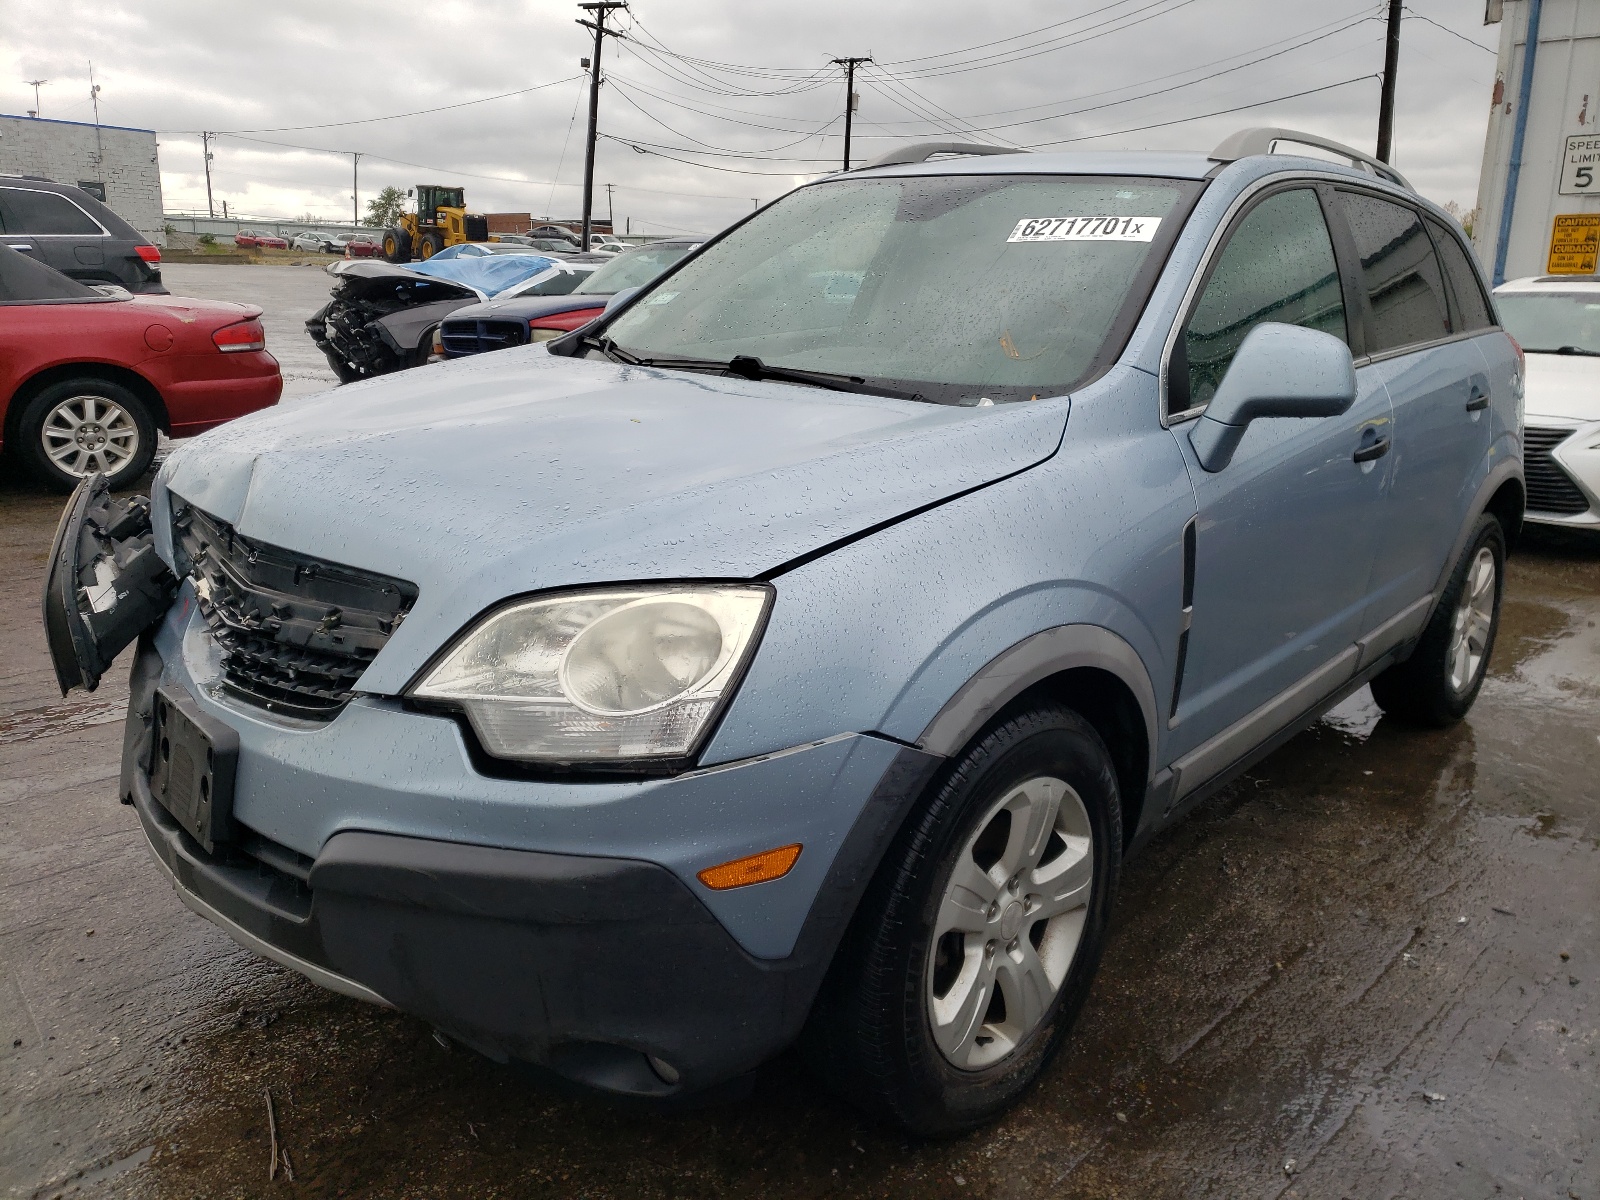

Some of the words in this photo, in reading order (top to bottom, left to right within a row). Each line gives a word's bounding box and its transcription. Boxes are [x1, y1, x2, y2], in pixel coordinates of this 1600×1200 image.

[1574, 166, 1593, 187] 5
[1559, 218, 1599, 226] CAUTION
[1554, 245, 1595, 253] CUIDADO
